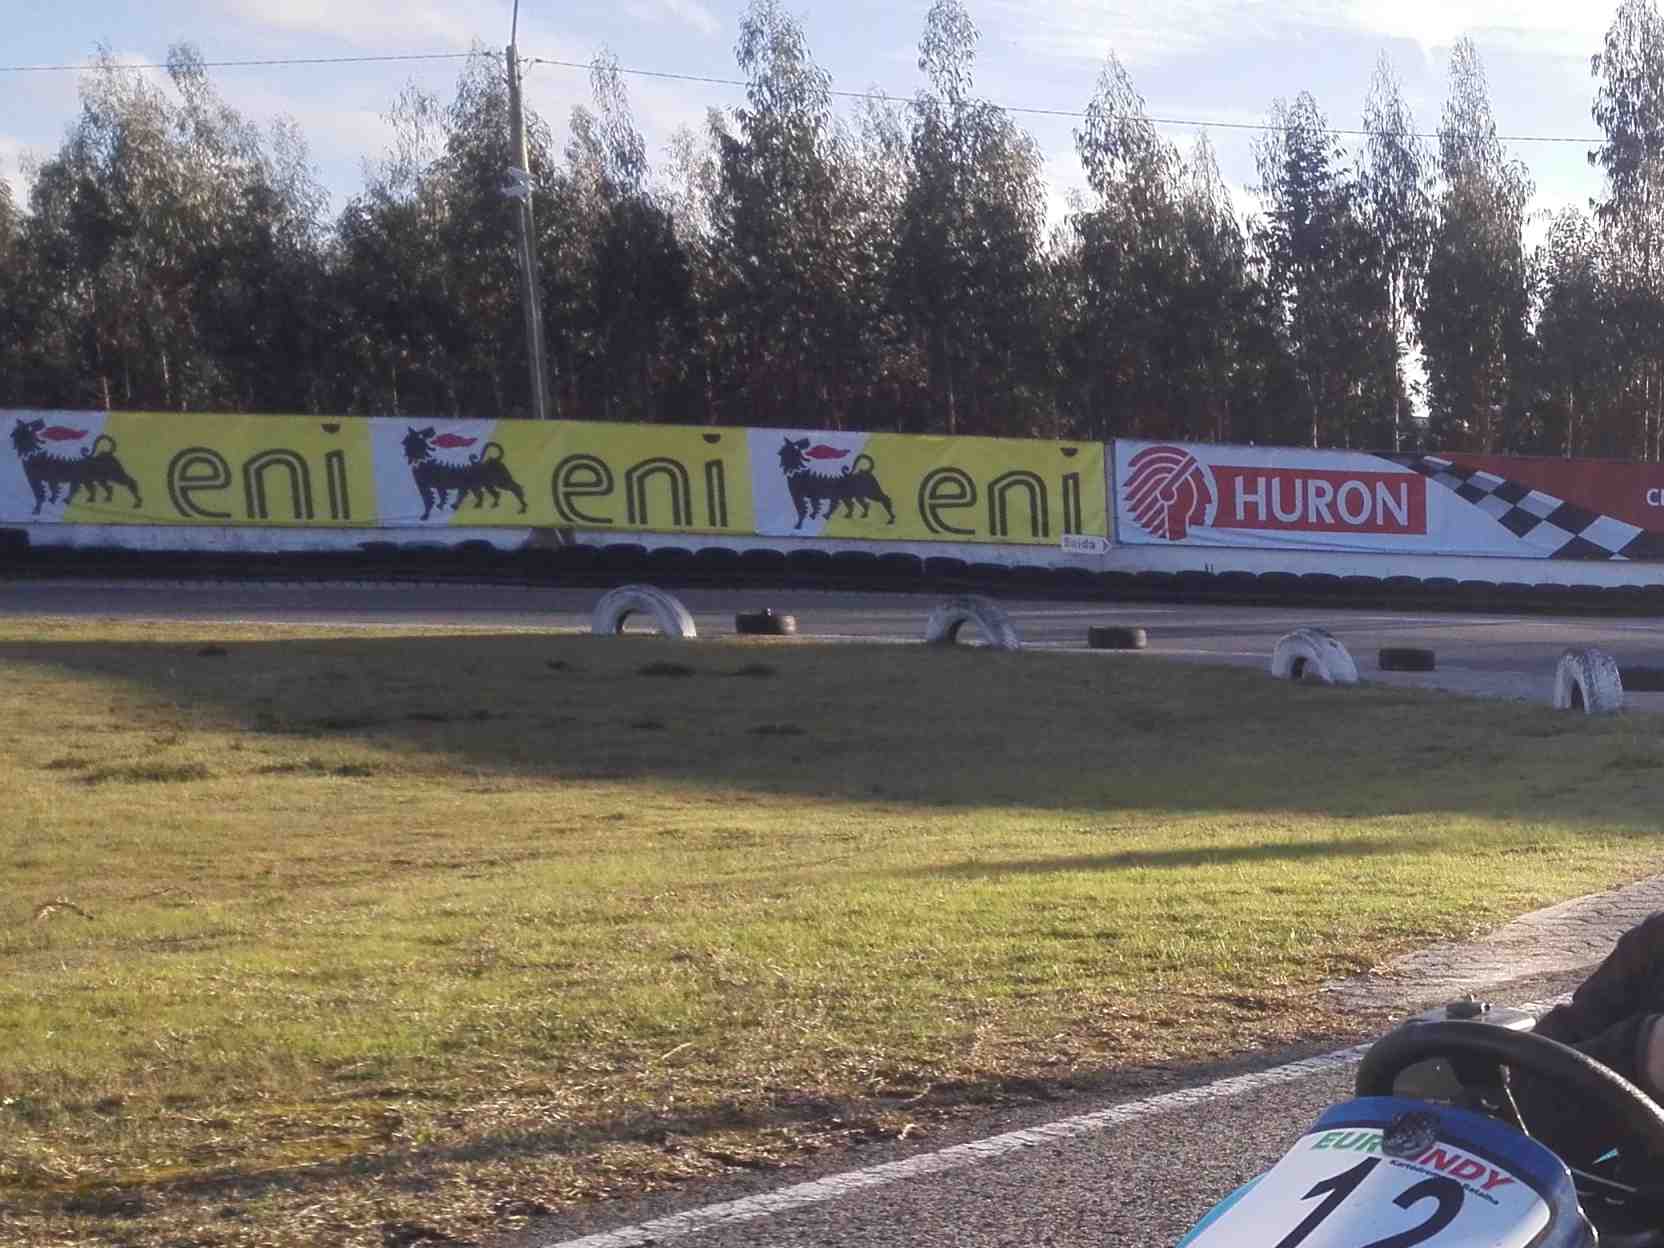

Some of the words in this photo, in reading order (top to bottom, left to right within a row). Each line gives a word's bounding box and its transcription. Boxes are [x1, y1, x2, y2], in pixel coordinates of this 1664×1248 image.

[168, 423, 351, 520] eni
[552, 433, 728, 527] eni
[918, 447, 1082, 538] eni
[1234, 474, 1408, 526] HURON
[1311, 1131, 1516, 1192] EURNDY
